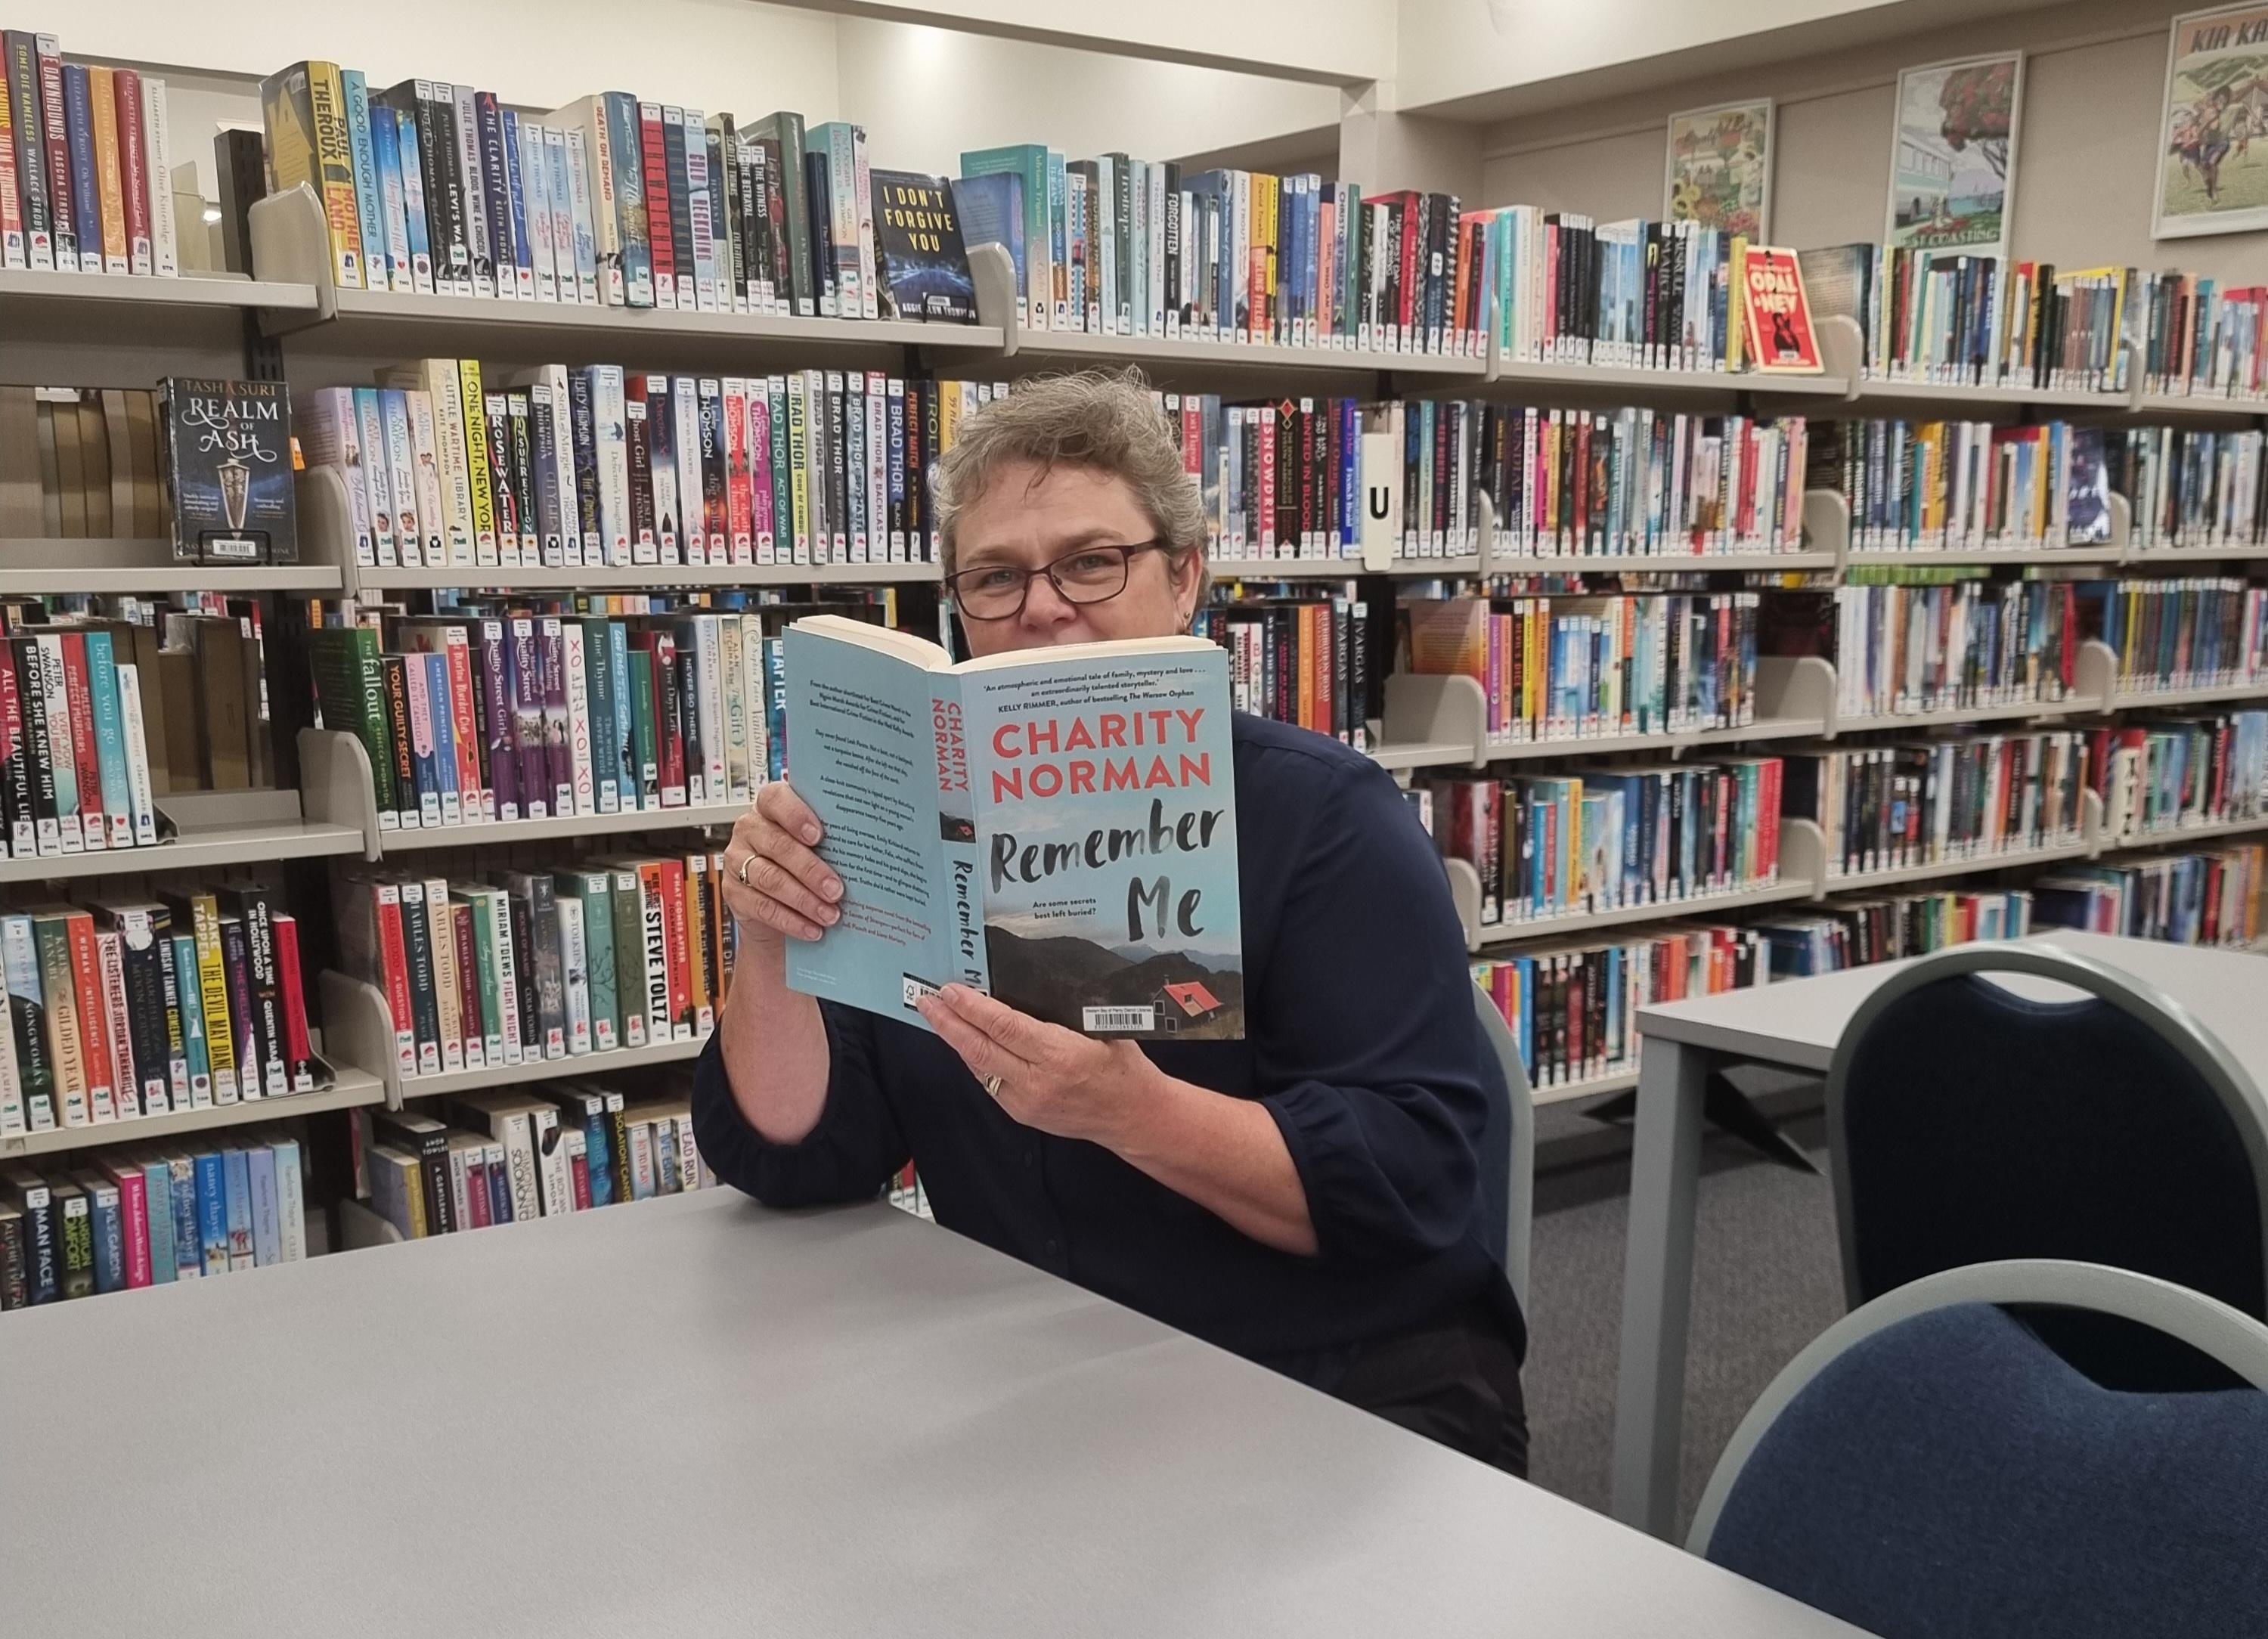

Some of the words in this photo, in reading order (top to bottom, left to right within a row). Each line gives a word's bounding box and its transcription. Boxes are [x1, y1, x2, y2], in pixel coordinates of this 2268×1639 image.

[2189, 25, 2231, 53] KIA
[18, 45, 28, 70] SOME
[20, 74, 29, 90] DIE
[22, 92, 35, 142] NAMELESS
[43, 67, 64, 140] DAWNHOUNDS
[314, 79, 337, 160] THEROUX
[354, 94, 366, 133] GOOD
[463, 101, 472, 124] JULIE
[486, 110, 495, 132] THE
[334, 118, 349, 160] PAUL
[596, 107, 606, 140] DEATH
[358, 138, 371, 189] ENOUGH
[466, 129, 476, 162] THOMAS
[600, 143, 608, 156] ON
[26, 149, 40, 192] WALLACE
[54, 150, 64, 185] SASCHA
[157, 166, 166, 191] Olive
[469, 167, 479, 192] BLOOD,
[488, 140, 503, 194] CLARITY
[602, 160, 612, 201] DEMAND
[689, 154, 706, 181] COLD
[756, 167, 764, 181] THE
[31, 196, 43, 232] STROBY
[326, 187, 344, 231] LAND
[364, 194, 376, 237] MOTHER
[448, 183, 459, 220] LEVI'S
[472, 195, 481, 214] WINE
[757, 184, 767, 218] WITNESS
[883, 186, 890, 204] I
[897, 187, 943, 209] DON'T
[158, 195, 169, 243] Kitteridge
[692, 200, 711, 260] RECKONING
[885, 209, 953, 231] FORGIVE
[1167, 194, 1179, 254] FORGOTTEN
[476, 225, 487, 258] CHOCOLA
[908, 233, 940, 252] YOU
[184, 380, 237, 395] TASHA
[239, 384, 275, 396] SURI
[446, 384, 457, 417] LITTLE
[468, 381, 479, 412] ONE
[181, 398, 278, 429] REALM
[702, 396, 712, 458] THOMSON
[832, 396, 842, 433] BRAD
[891, 405, 903, 448] BRAD
[199, 430, 277, 462] ASH
[450, 423, 462, 472] WARTIME
[470, 417, 485, 463] NIGHT,
[834, 438, 843, 474] THOR
[476, 467, 488, 501] NEW
[492, 416, 513, 533] ROSEWATER
[516, 418, 534, 533] INSURRECTION
[892, 454, 903, 493] THOR
[1264, 426, 1274, 526] SNOWDRIF
[1303, 466, 1310, 479] IN
[455, 477, 466, 521] LIBRARY
[479, 503, 491, 531] YOR
[779, 500, 785, 513] OF
[1303, 485, 1311, 530] BLOOD
[1370, 487, 1389, 519] U
[96, 643, 110, 688] before
[1338, 623, 1347, 680] VARGAS
[1355, 626, 1364, 683] VARGAS
[2, 669, 15, 692] ALL
[26, 646, 43, 696] BEFORE
[41, 646, 54, 699] SWANSON
[53, 659, 63, 686] PETER
[362, 658, 383, 720] fallout
[390, 666, 402, 698] YOUR
[998, 680, 1038, 692] atmospheric
[1054, 674, 1087, 683] emotional
[1111, 671, 1135, 680] family,
[1136, 669, 1163, 678] mystery
[1041, 686, 1090, 696] extraordinarily
[1092, 682, 1119, 690] talented
[6, 697, 20, 721] THE
[32, 701, 45, 725] SHE
[101, 694, 113, 720] you
[395, 701, 407, 738] GUILTY
[998, 704, 1021, 713] KELLY
[1024, 700, 1058, 708] RIMMER,
[1092, 694, 1128, 703] bestselling
[36, 730, 51, 768] KNEW
[103, 728, 116, 744] go
[932, 699, 952, 791] NORMAN
[948, 703, 968, 792] CHARITY
[993, 708, 1205, 758] CHARITY
[10, 727, 30, 798] BEAUTIFUL
[398, 741, 411, 779] SECRET
[42, 774, 54, 800] HIM
[993, 753, 1210, 804] NORMAN
[19, 803, 31, 822] LIE
[991, 798, 1224, 894] Remember
[249, 909, 256, 919] IN
[257, 901, 268, 927] ONCE
[497, 899, 508, 938] MIRIAM
[953, 860, 979, 959] Remember
[1128, 876, 1204, 942] Me
[194, 903, 209, 960] TAPPER
[207, 912, 219, 950] JAKE
[259, 930, 270, 954] UPON
[646, 912, 664, 968] STEVE
[159, 939, 174, 972] LINDSAY
[249, 922, 264, 979] HOLLYWOOD
[501, 942, 511, 978] TOEWS
[164, 975, 177, 1007] TANNER
[202, 963, 221, 983] THE
[264, 966, 274, 985] TIME
[205, 987, 225, 1016] DEVIL
[504, 981, 514, 1010] FIGHT
[650, 971, 668, 1025] TOLTZ
[168, 1009, 181, 1052] COMEBACK
[210, 1020, 228, 1040] MAY
[264, 1000, 275, 1038] QUENTIN
[507, 1015, 517, 1045] NIGHT
[25, 1002, 42, 1086] SONGWOMAN
[57, 1005, 75, 1054] GILDED
[66, 1058, 80, 1093] YEAR
[685, 1161, 696, 1185] RUN
